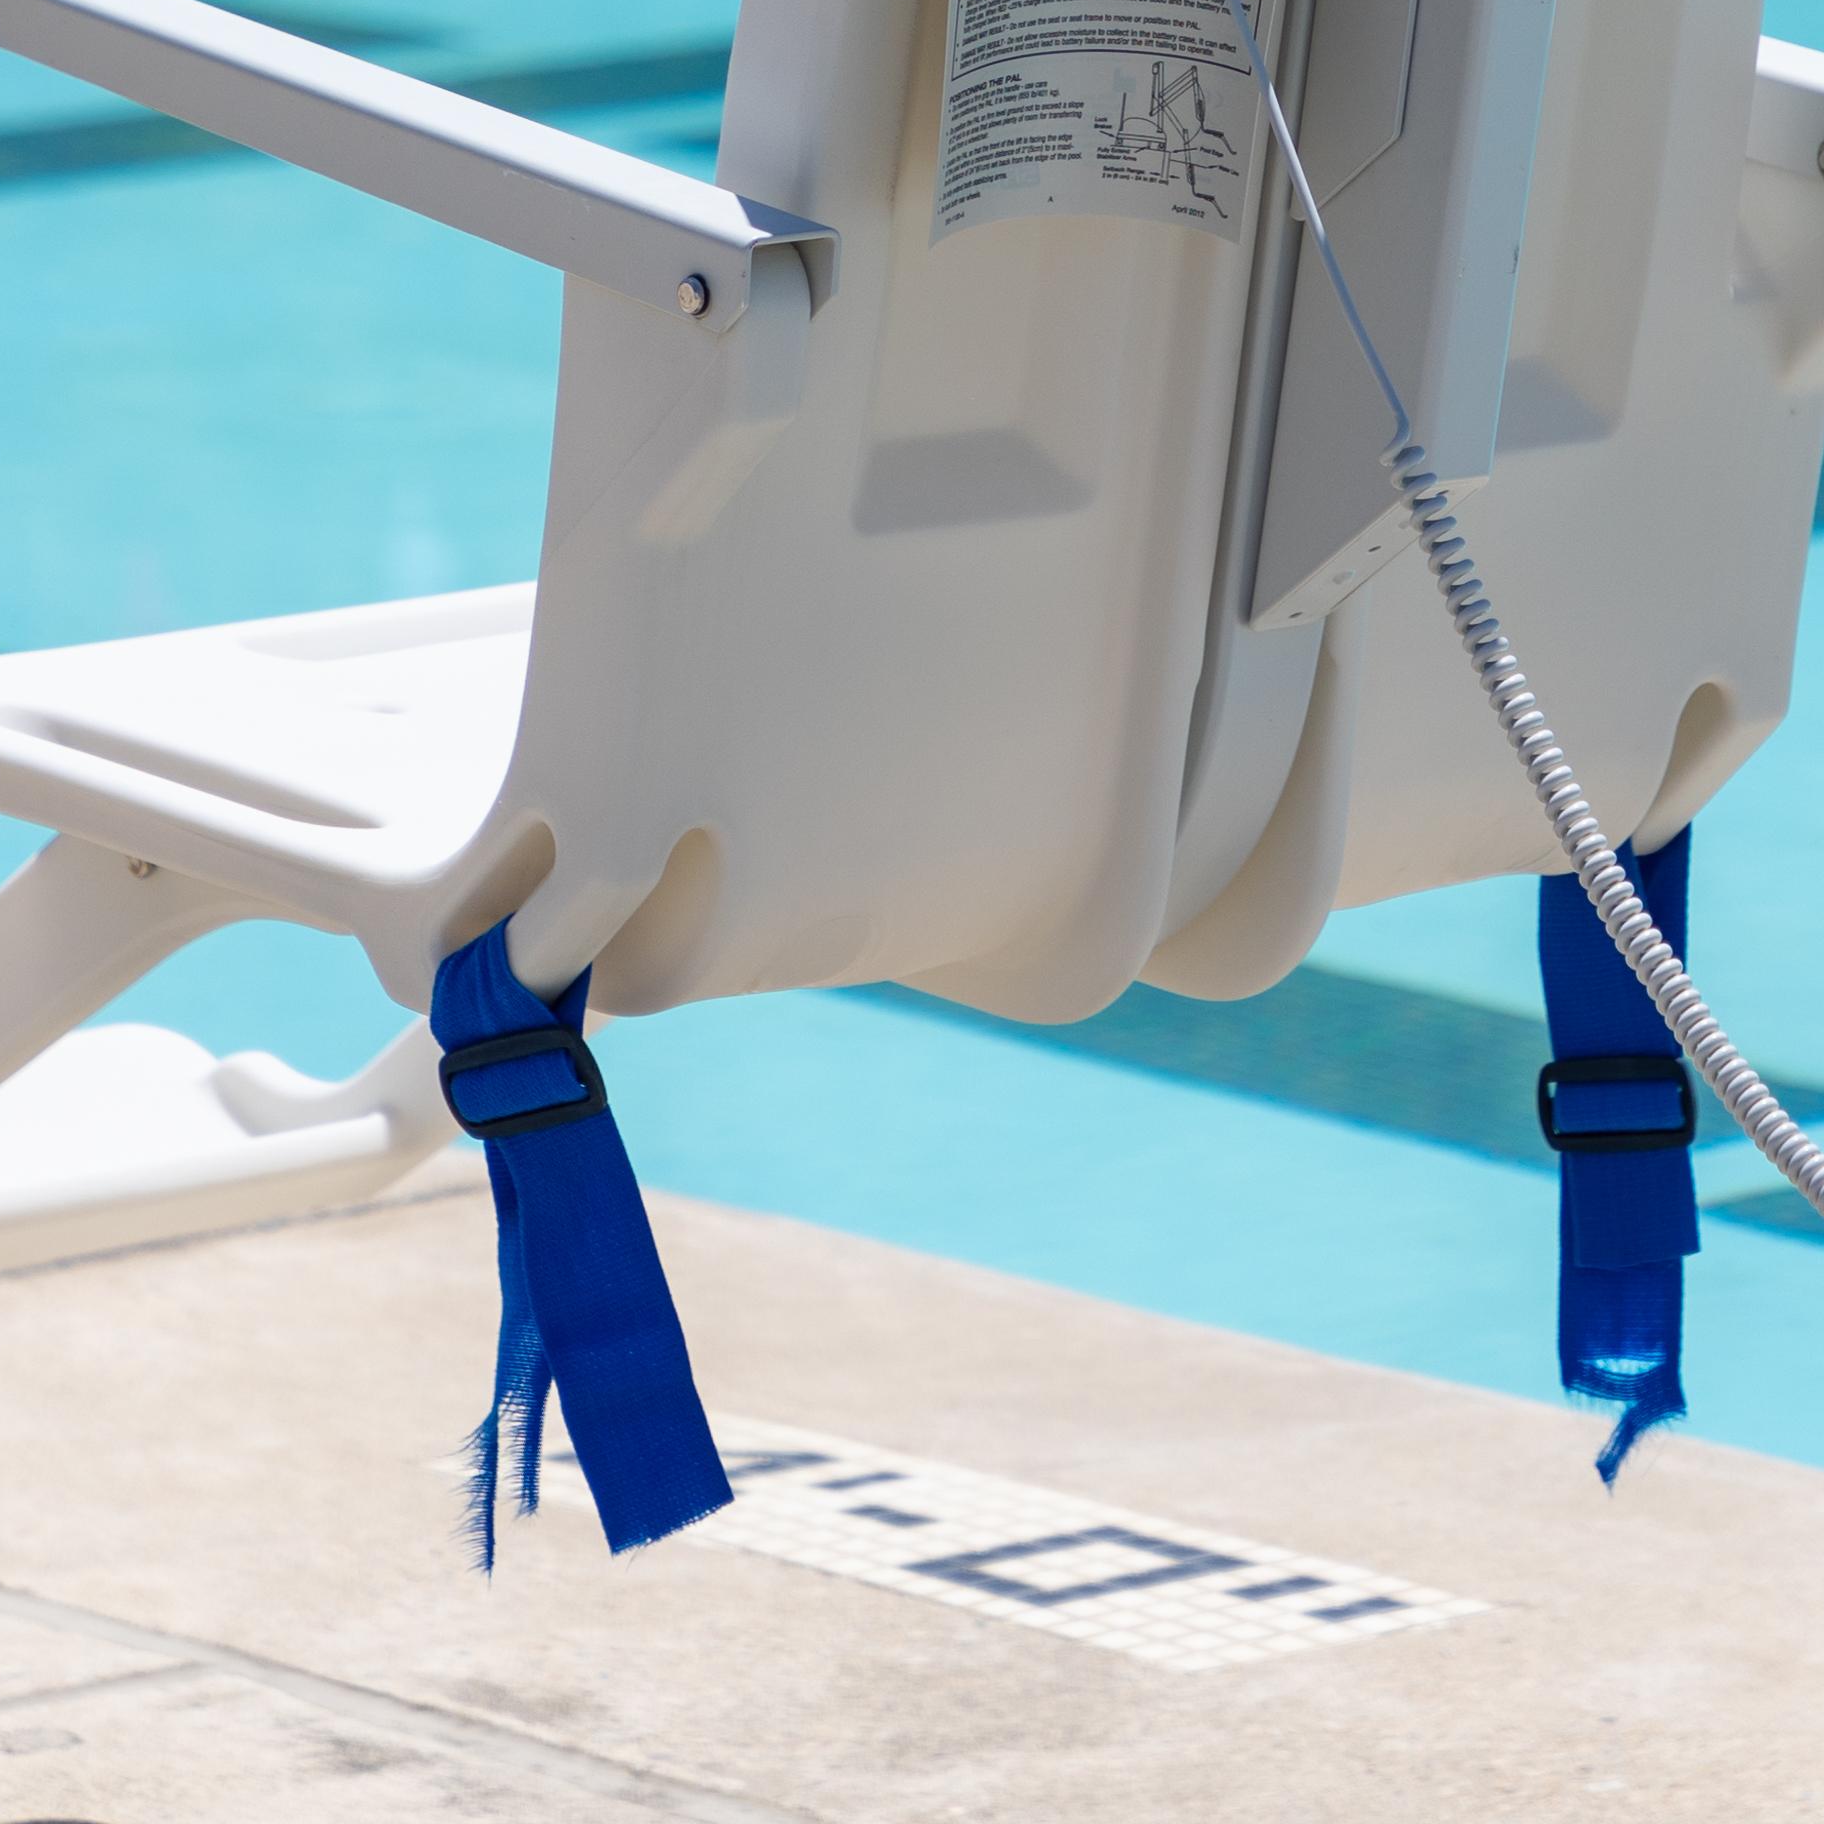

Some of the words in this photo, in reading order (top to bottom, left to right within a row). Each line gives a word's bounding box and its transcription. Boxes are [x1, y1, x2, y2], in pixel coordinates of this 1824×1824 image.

[989, 77, 1004, 87] THE
[1005, 73, 1023, 84] PAL
[1171, 204, 1188, 214] April
[1188, 207, 1205, 219] 2012
